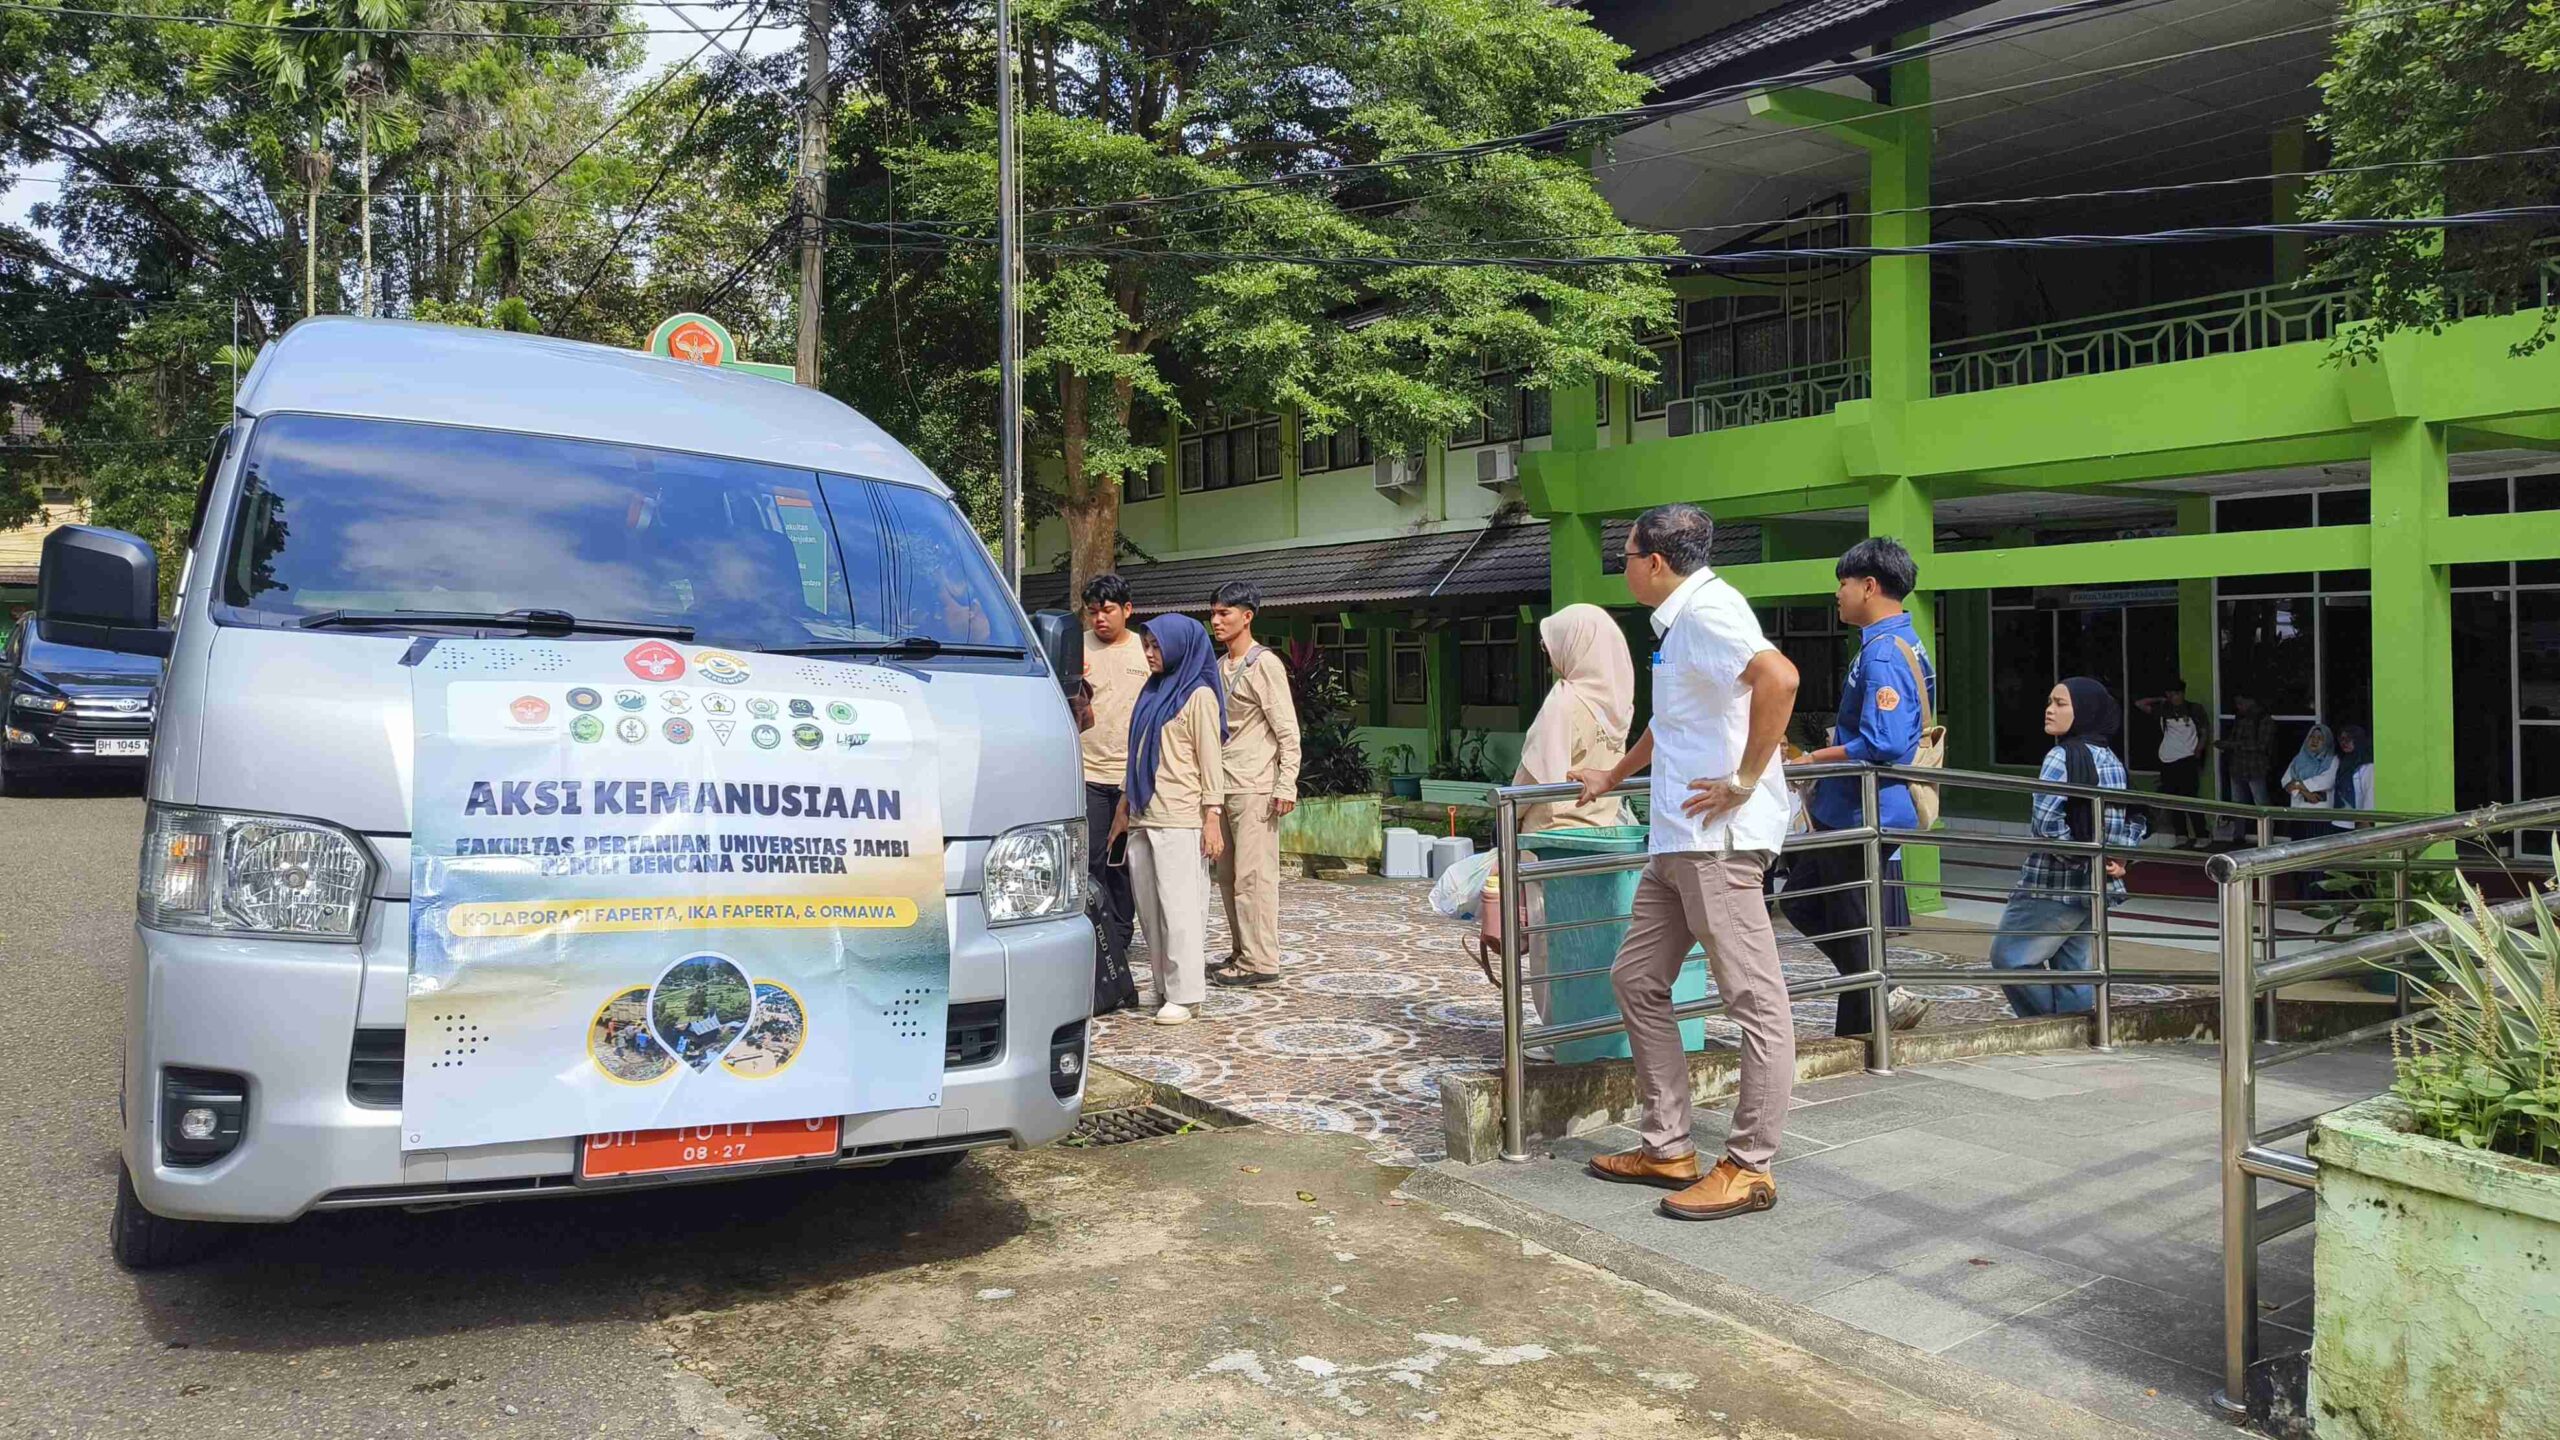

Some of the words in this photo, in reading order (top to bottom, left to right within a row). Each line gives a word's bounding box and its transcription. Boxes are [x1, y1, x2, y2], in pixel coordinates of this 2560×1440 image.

[98, 741, 111, 749] BH
[117, 741, 141, 749] 1045
[464, 781, 582, 816] AKSI
[594, 781, 901, 820] KEMANUSIAAN
[455, 837, 575, 856] FAKULTAS
[584, 835, 711, 855] PERTANIAN
[719, 835, 847, 856] UNIVERSITAS
[853, 838, 910, 857] JAMBI
[629, 854, 735, 875] BENCANA
[742, 854, 848, 875] SUMATERA
[595, 906, 683, 922] FAPERTA,
[688, 905, 718, 919] IKA
[723, 904, 800, 920] FAPERTA,
[804, 905, 816, 918] &
[820, 905, 896, 919] ORMAWA
[1096, 923, 1109, 952] POLO
[1105, 954, 1118, 981] KING
